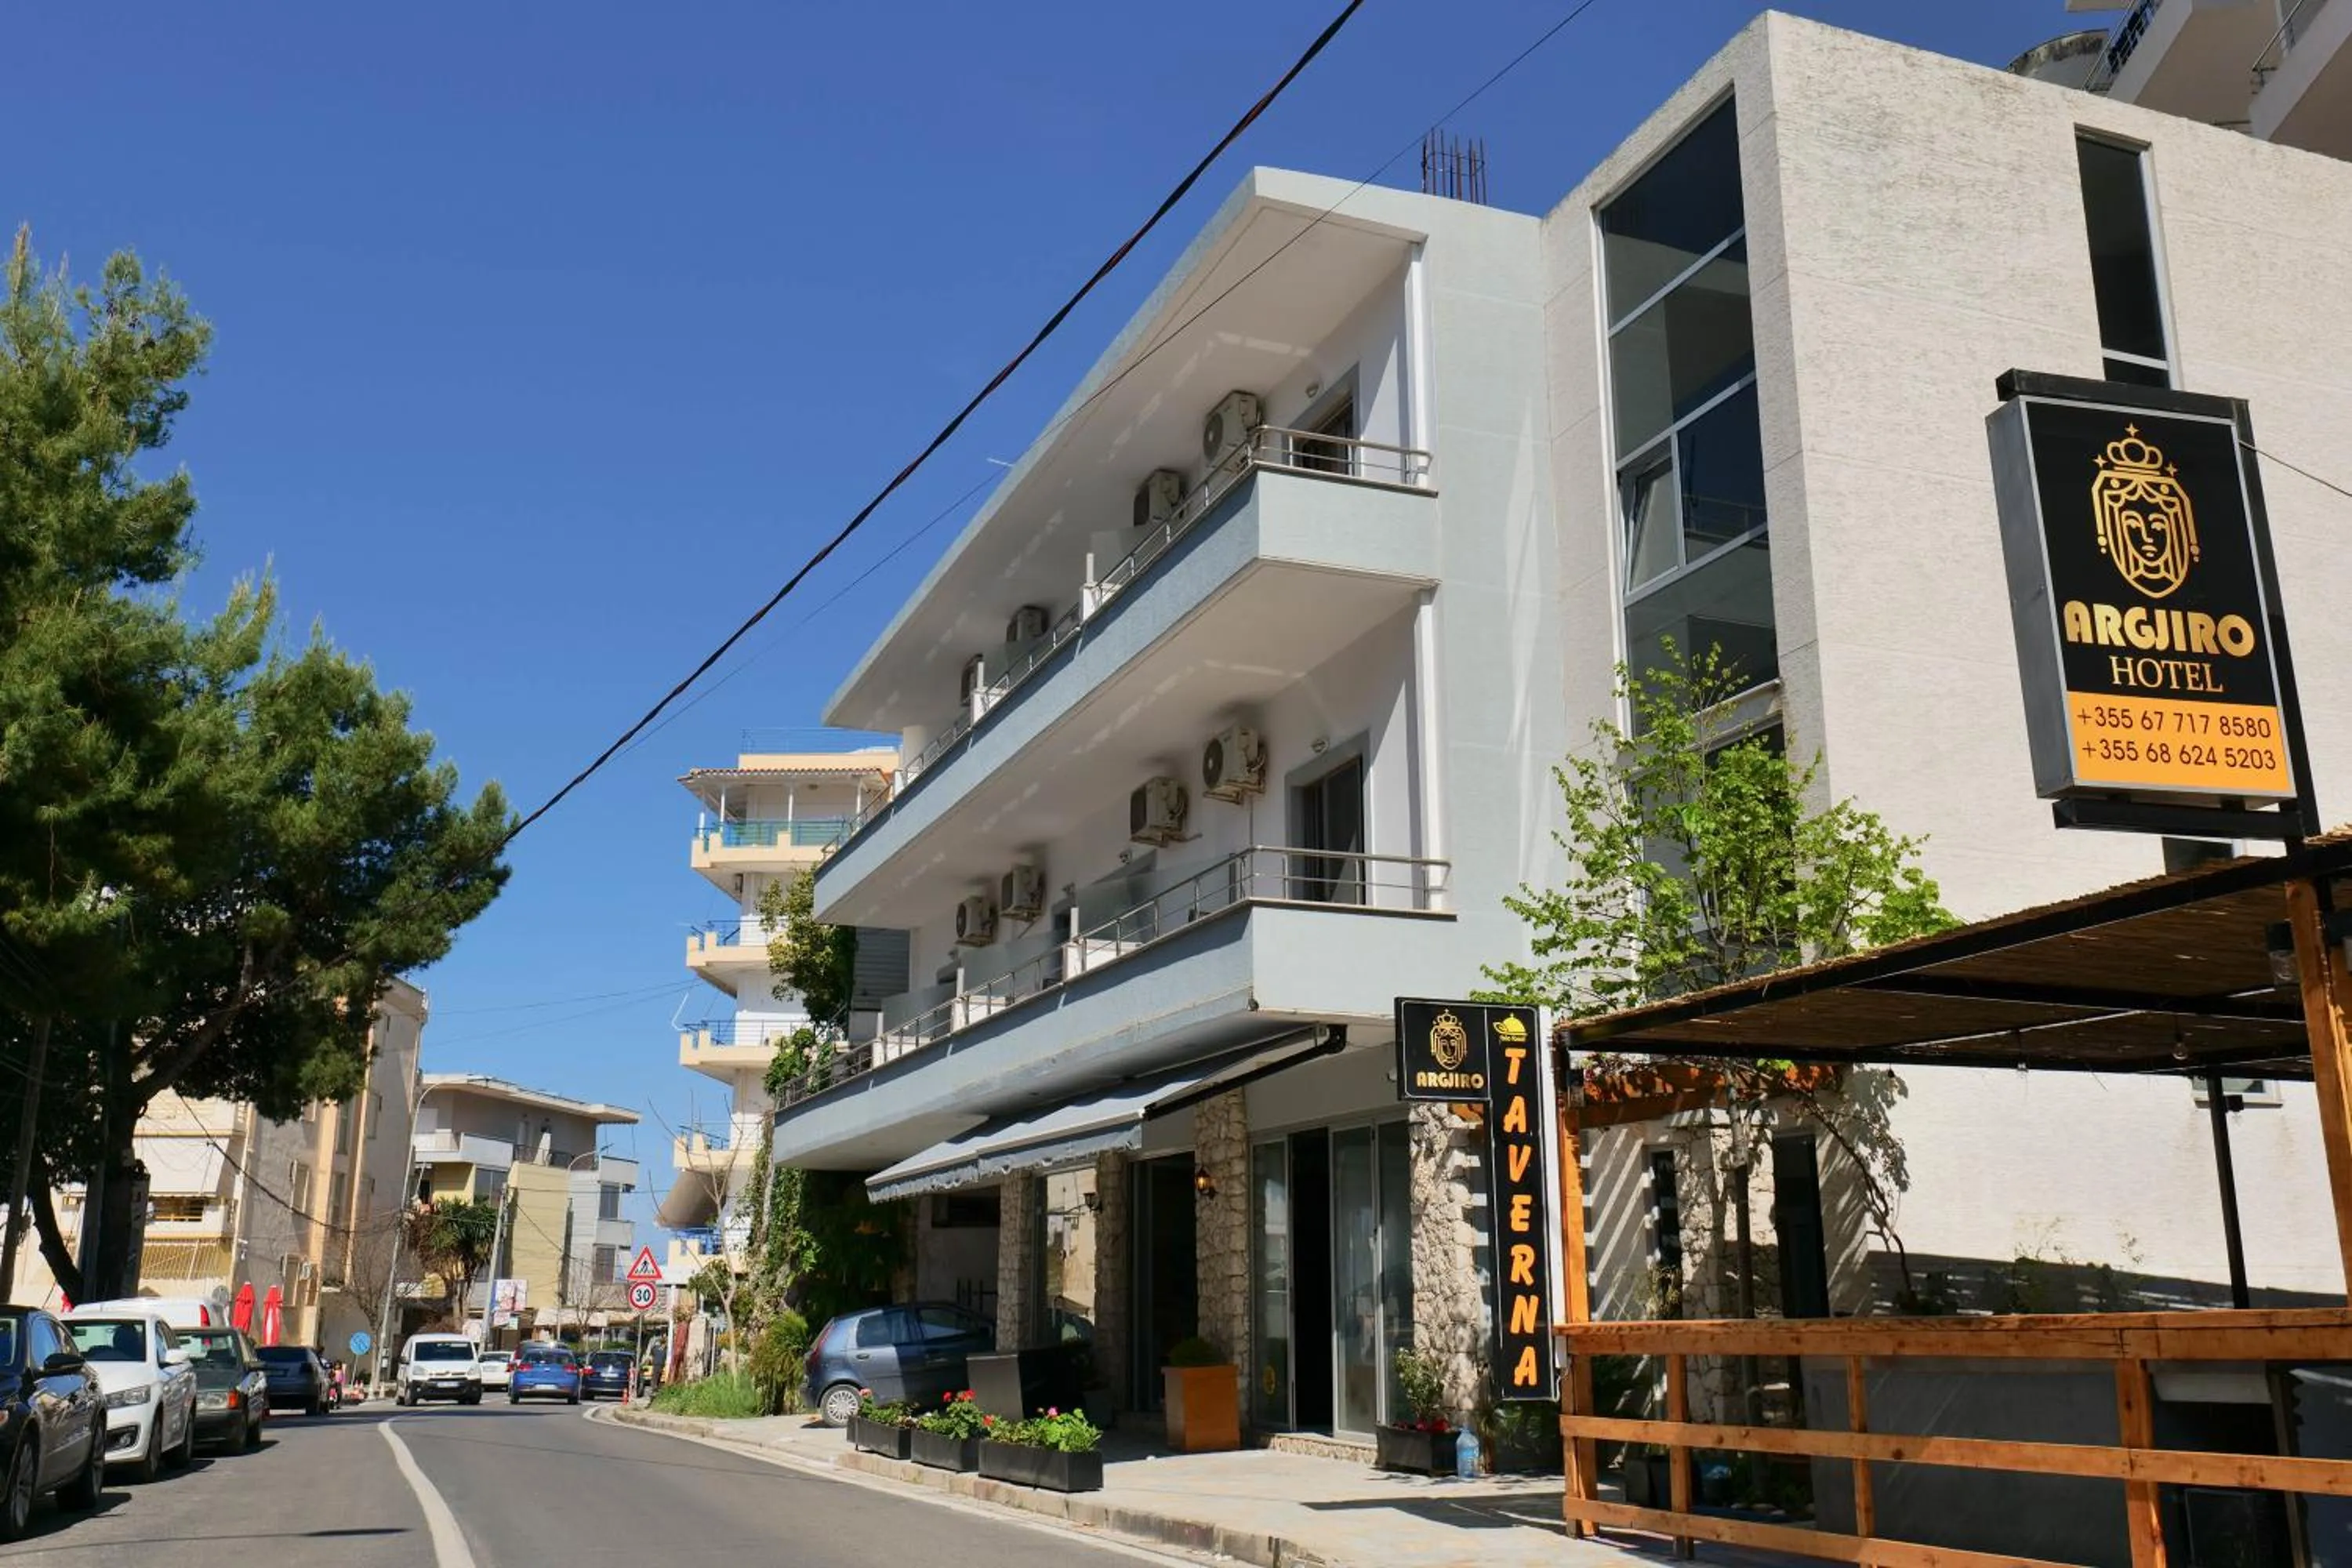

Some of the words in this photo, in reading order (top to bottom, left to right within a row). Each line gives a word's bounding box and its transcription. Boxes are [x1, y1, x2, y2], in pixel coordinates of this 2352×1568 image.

[2063, 600, 2255, 657] ARGJIRO
[2109, 655, 2223, 692] HOTEL
[2077, 706, 2133, 729] +355
[2140, 710, 2164, 731] 67
[2173, 713, 2210, 735] 717
[2220, 716, 2271, 739] 8580
[2082, 739, 2139, 762] +355
[2146, 742, 2171, 764] 68
[2179, 745, 2217, 766] 624
[2224, 747, 2276, 770] 5203
[1417, 1071, 1484, 1089] ARGJIRO
[1504, 1047, 1539, 1386] TAVERNA
[636, 1288, 651, 1302] 30
